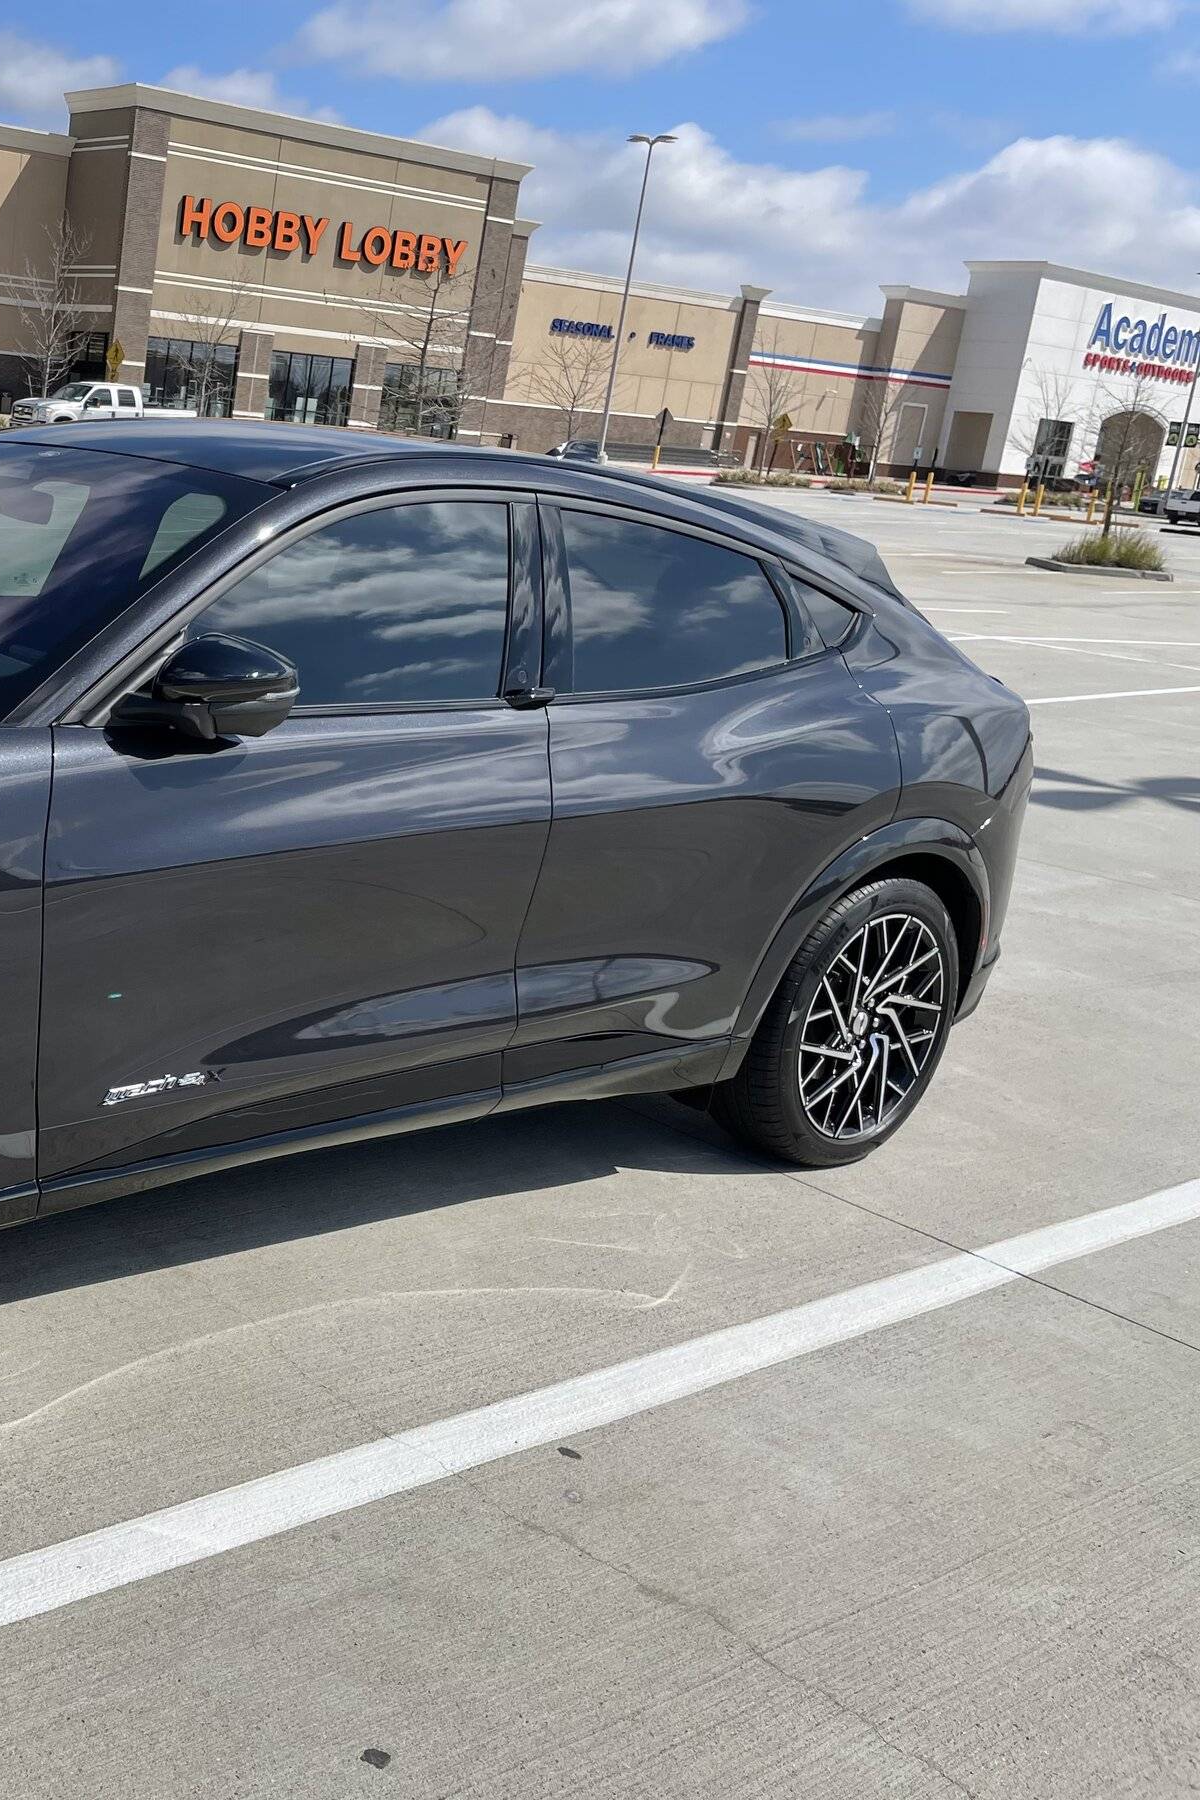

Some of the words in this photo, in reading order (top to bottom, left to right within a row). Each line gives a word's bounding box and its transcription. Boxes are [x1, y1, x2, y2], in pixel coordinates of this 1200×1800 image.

[180, 194, 330, 256] HOBBY
[340, 221, 468, 275] LOBBY
[550, 319, 615, 338] SEASONAL
[649, 332, 695, 350] FRAMES
